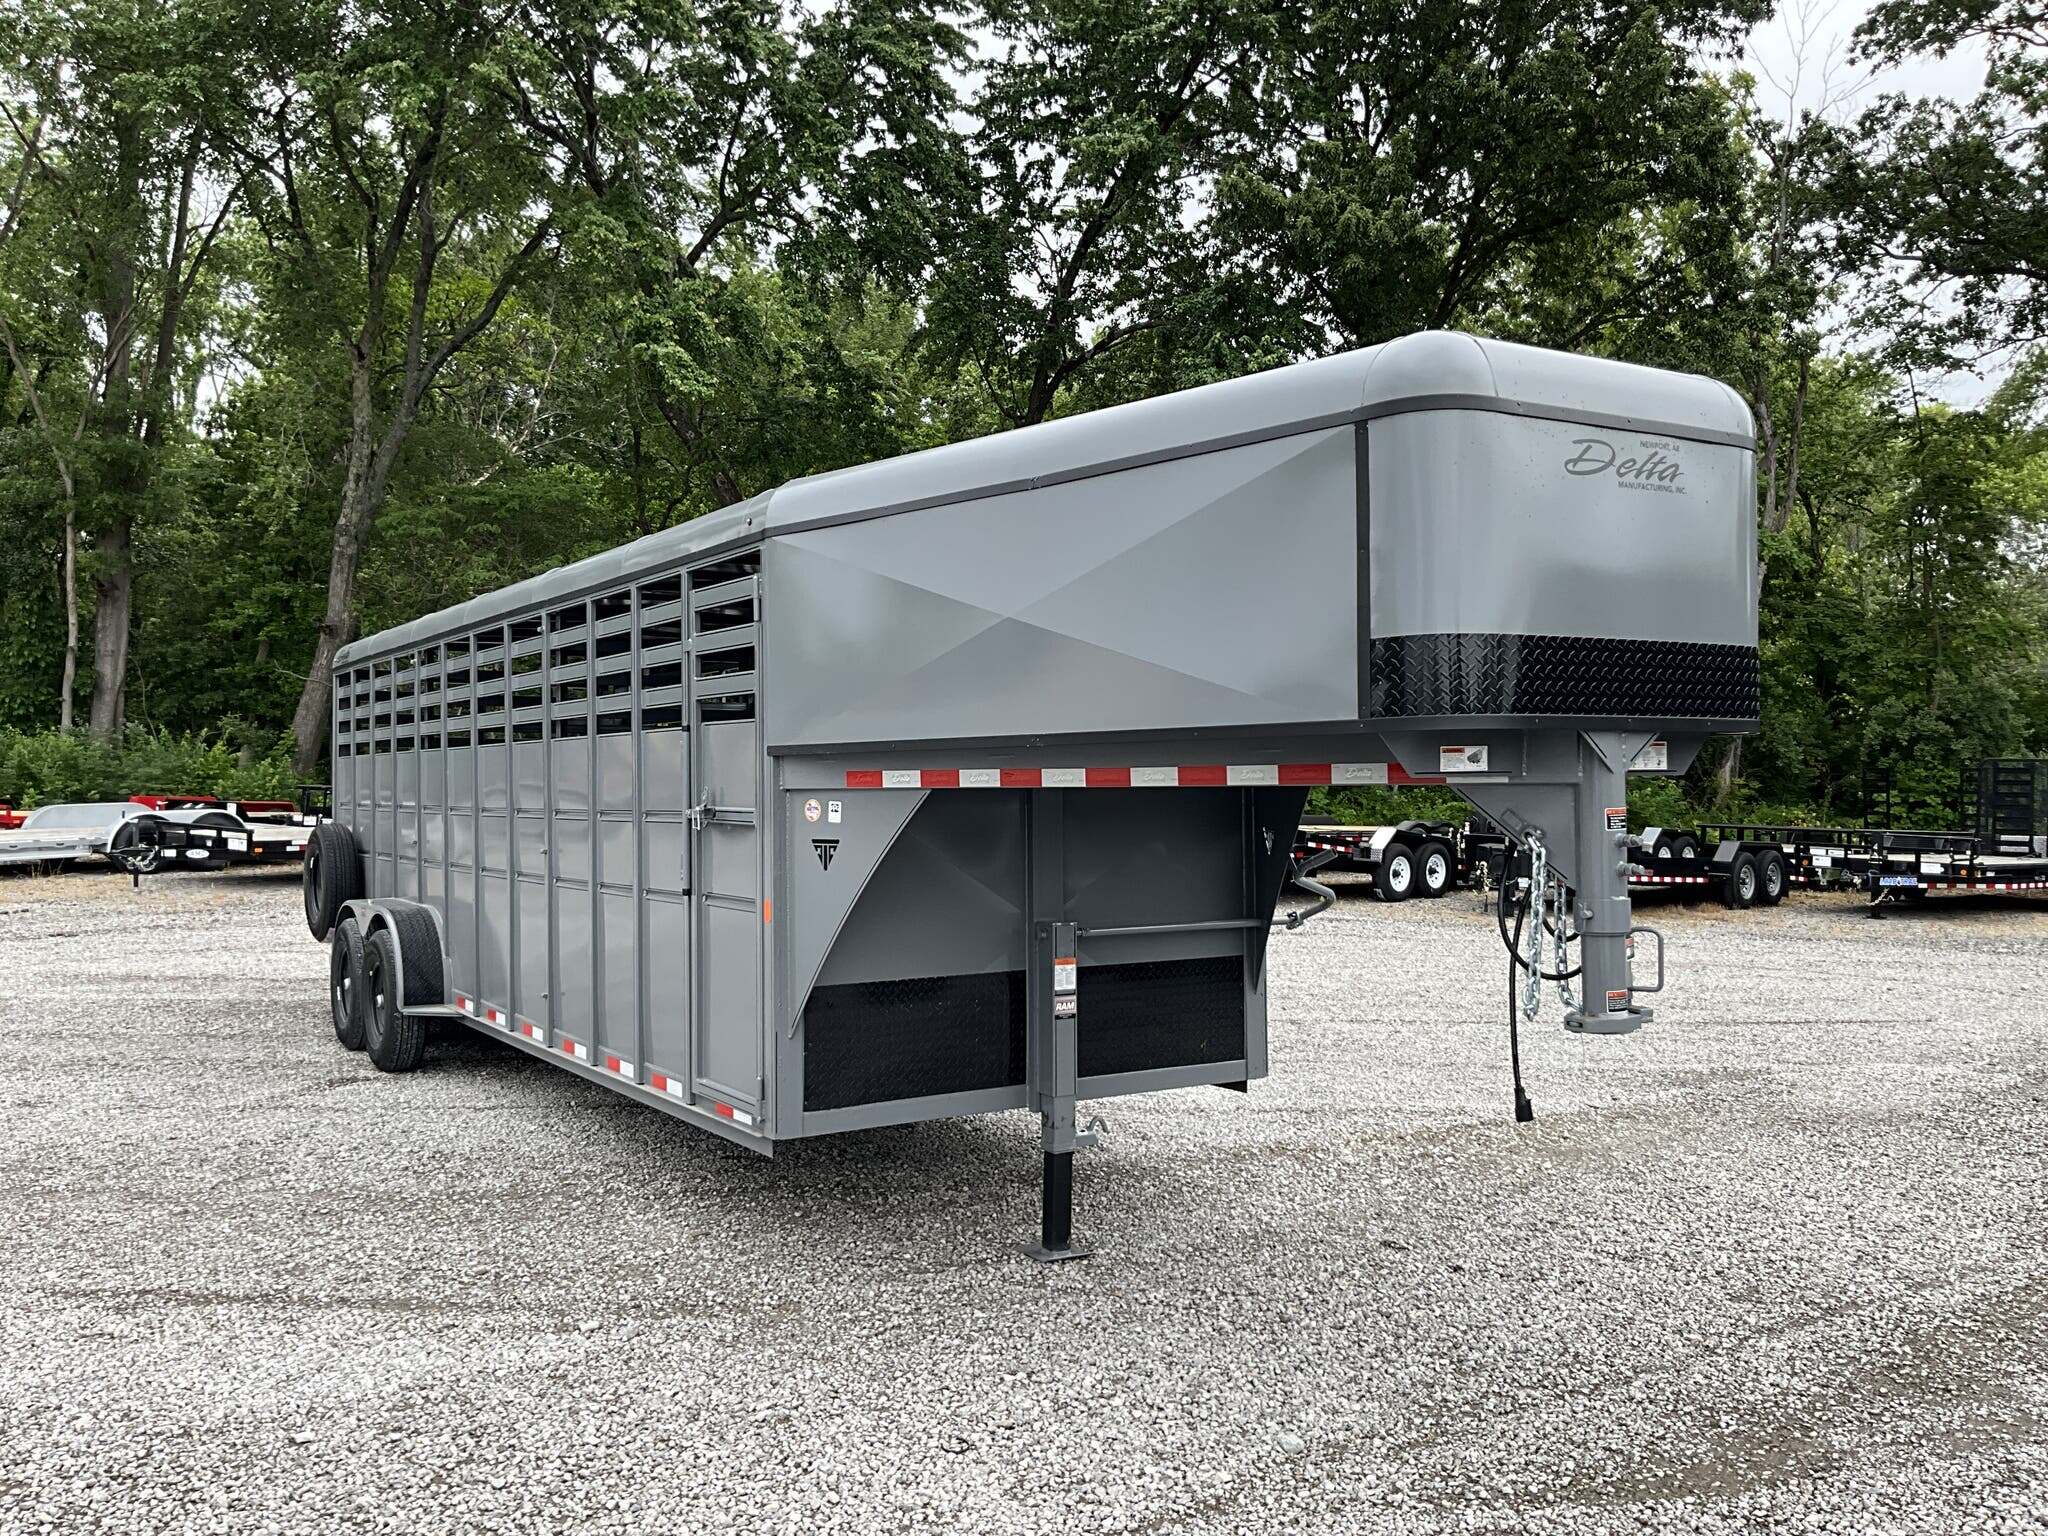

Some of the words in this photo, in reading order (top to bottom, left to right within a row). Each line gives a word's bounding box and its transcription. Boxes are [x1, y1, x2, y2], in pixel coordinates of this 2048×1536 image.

[1564, 438, 1684, 483] Delta
[1617, 481, 1674, 493] MANUFACTURING,
[1056, 1001, 1075, 1011] RAM
